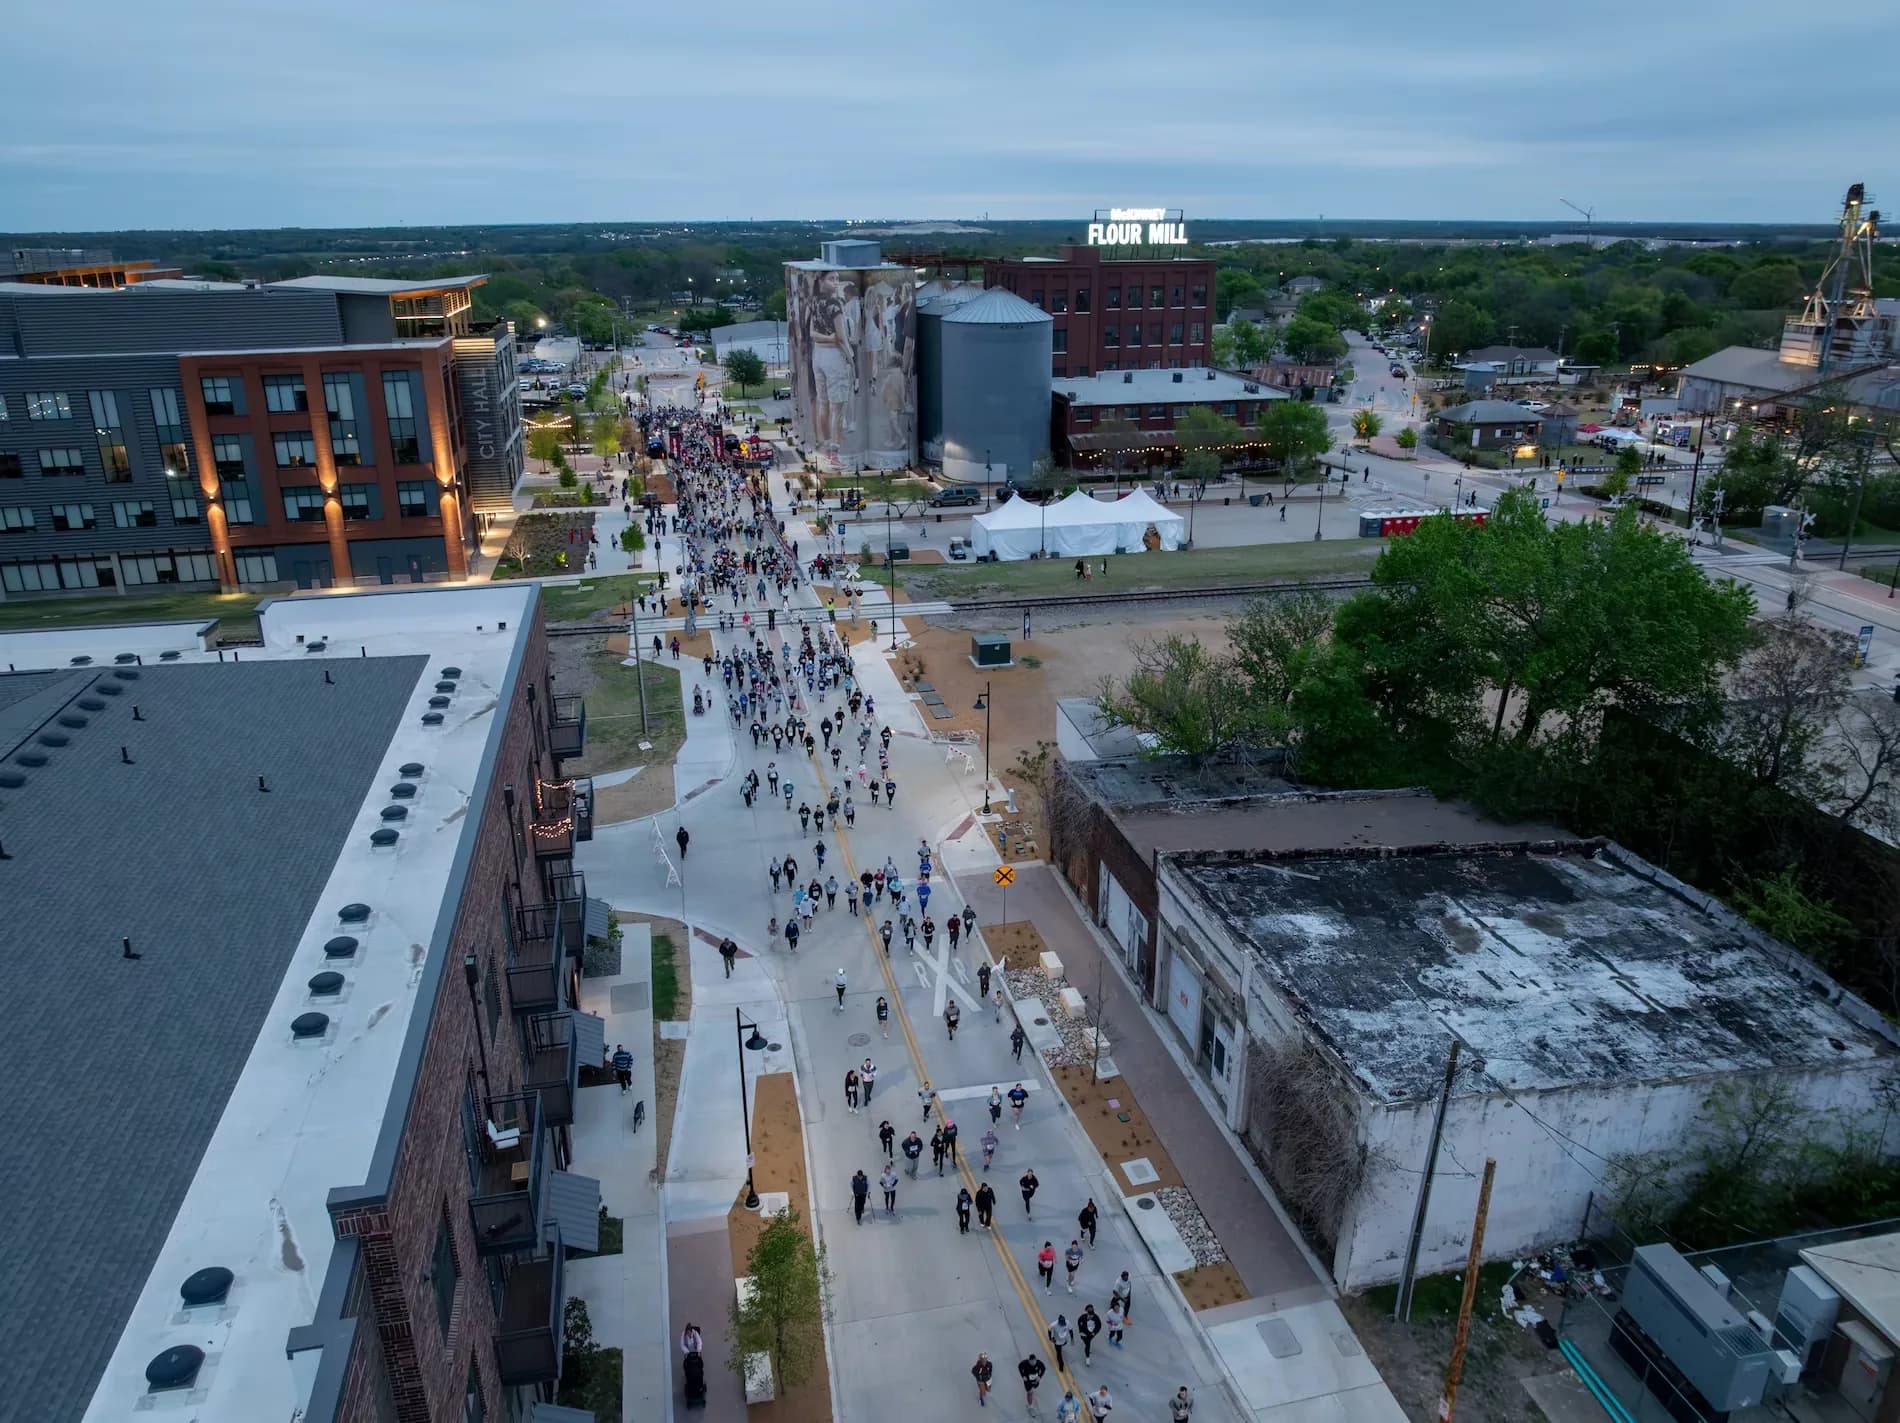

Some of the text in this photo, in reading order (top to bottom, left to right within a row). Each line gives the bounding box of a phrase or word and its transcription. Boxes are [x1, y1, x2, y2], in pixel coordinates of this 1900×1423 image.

[1088, 223, 1188, 246] FLOUR MILL
[471, 368, 495, 460] CITY HALL
